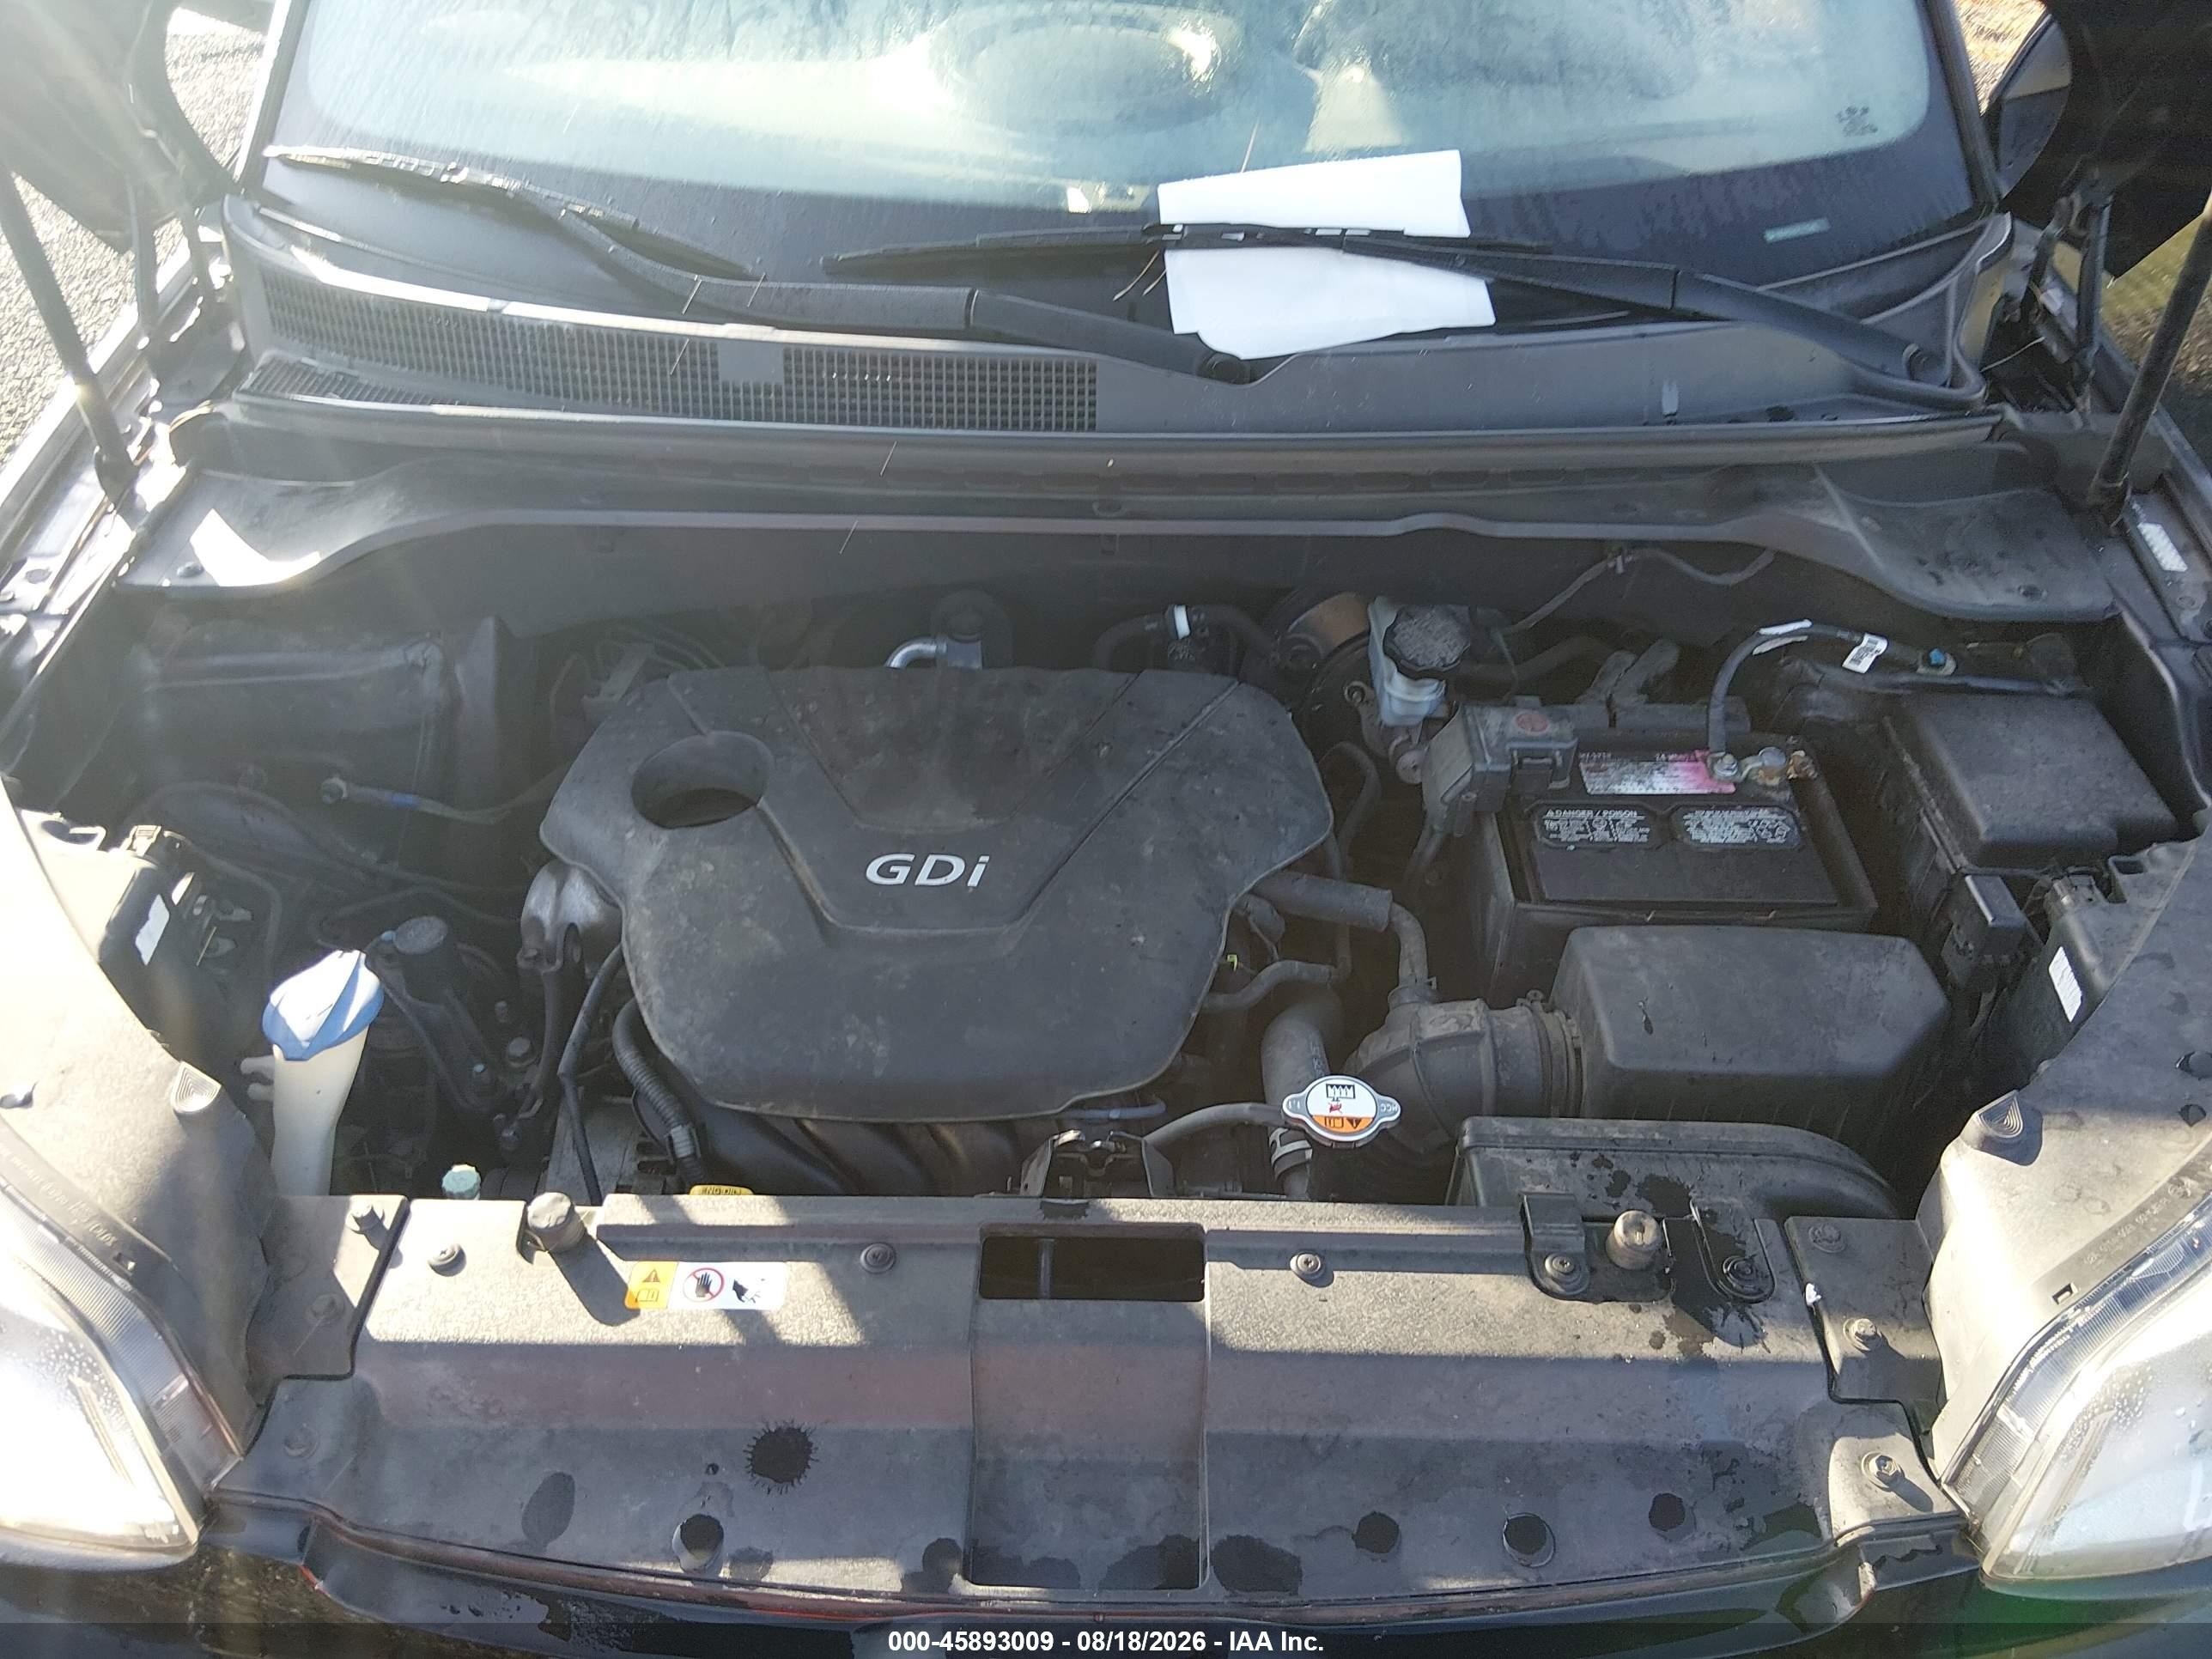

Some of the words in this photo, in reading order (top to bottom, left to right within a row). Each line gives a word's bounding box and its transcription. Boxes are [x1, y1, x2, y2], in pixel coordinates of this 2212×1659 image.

[1555, 809, 1594, 819] DANGER
[1601, 809, 1638, 819] POISON
[866, 853, 989, 887] GDi
